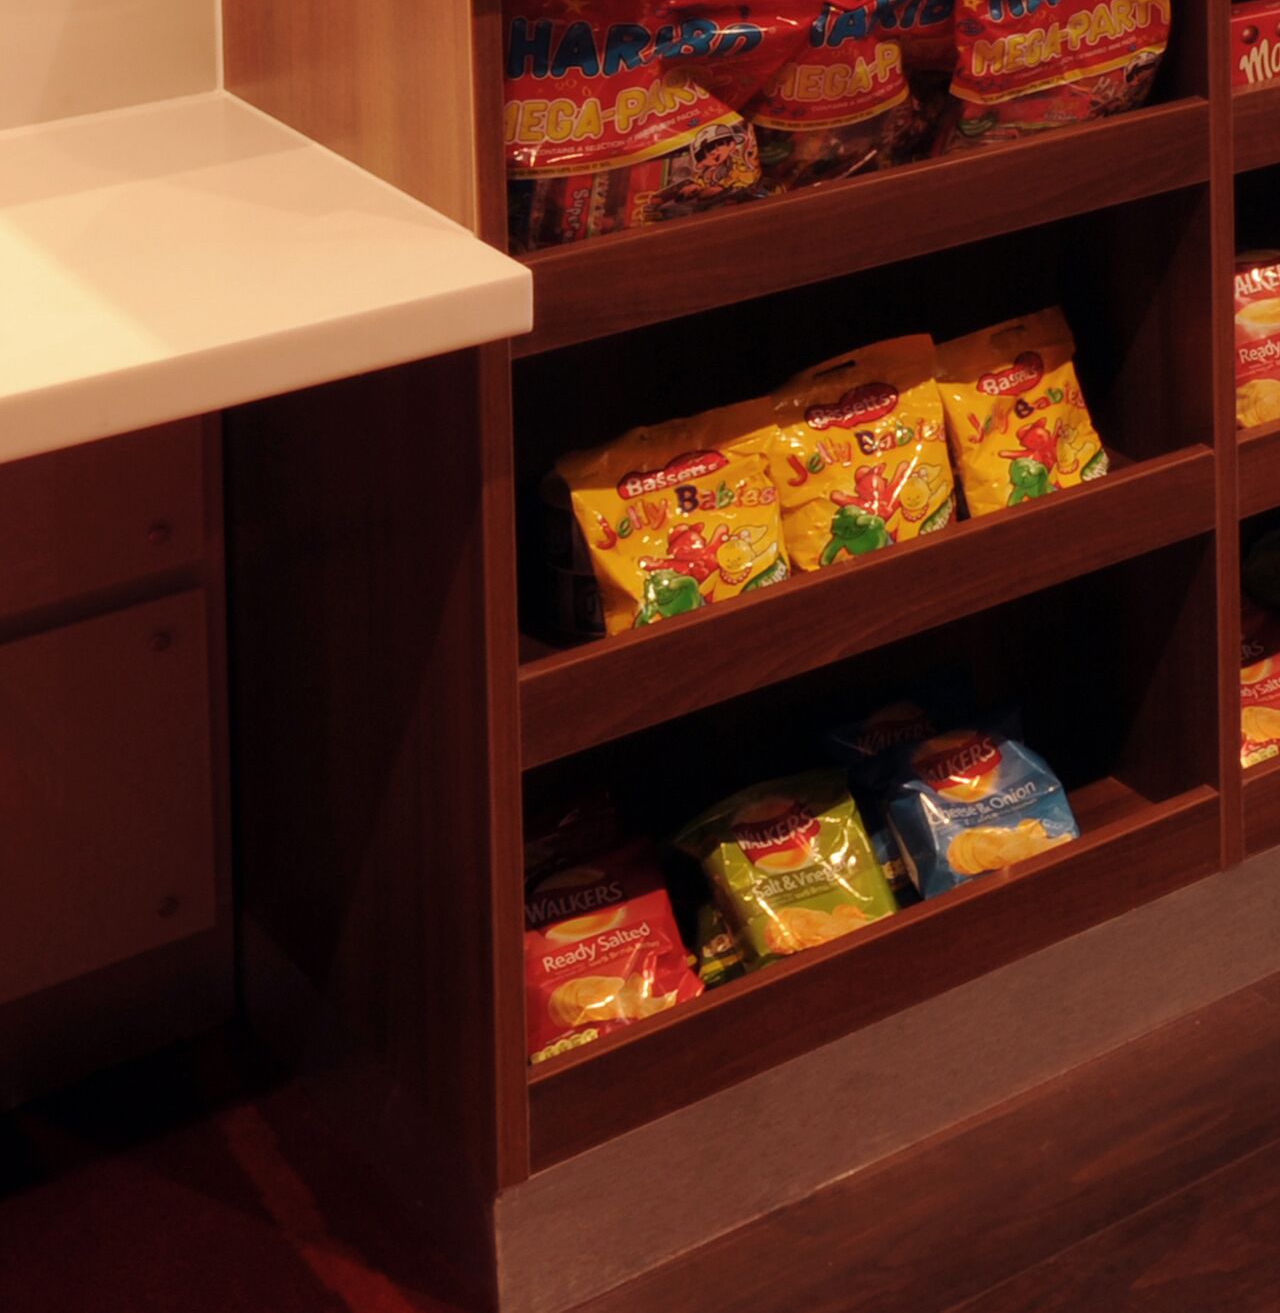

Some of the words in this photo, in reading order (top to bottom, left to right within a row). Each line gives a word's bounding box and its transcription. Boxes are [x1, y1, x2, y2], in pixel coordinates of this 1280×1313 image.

[1238, 337, 1280, 365] Ready
[787, 438, 853, 487] Jelly
[596, 498, 669, 551] Jelly
[675, 479, 777, 513] Babies
[988, 780, 1037, 810] Onion
[524, 880, 624, 925] WALKERS
[752, 877, 782, 900] Salt
[781, 875, 796, 893] &
[542, 942, 597, 974] Ready
[597, 920, 651, 955] Salted
